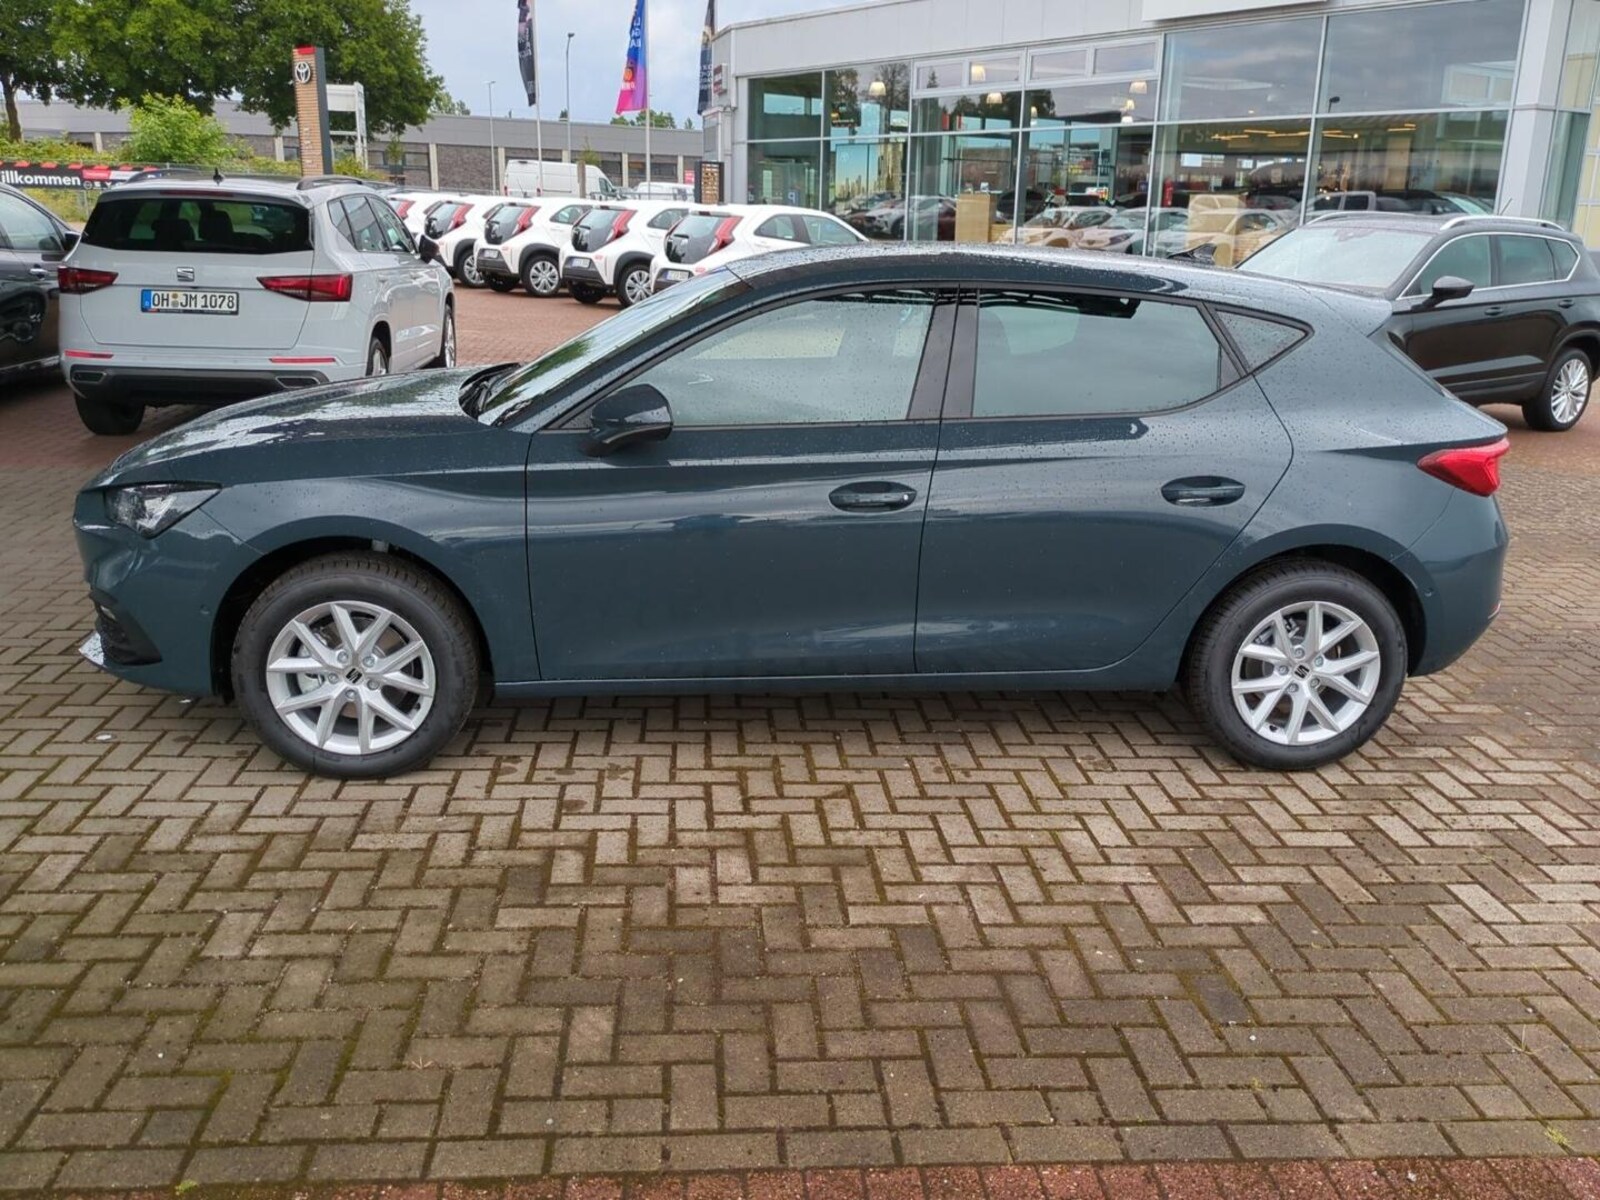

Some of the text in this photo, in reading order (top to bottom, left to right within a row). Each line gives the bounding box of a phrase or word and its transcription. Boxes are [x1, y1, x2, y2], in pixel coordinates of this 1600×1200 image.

[152, 293, 235, 308] OH JM 1078
